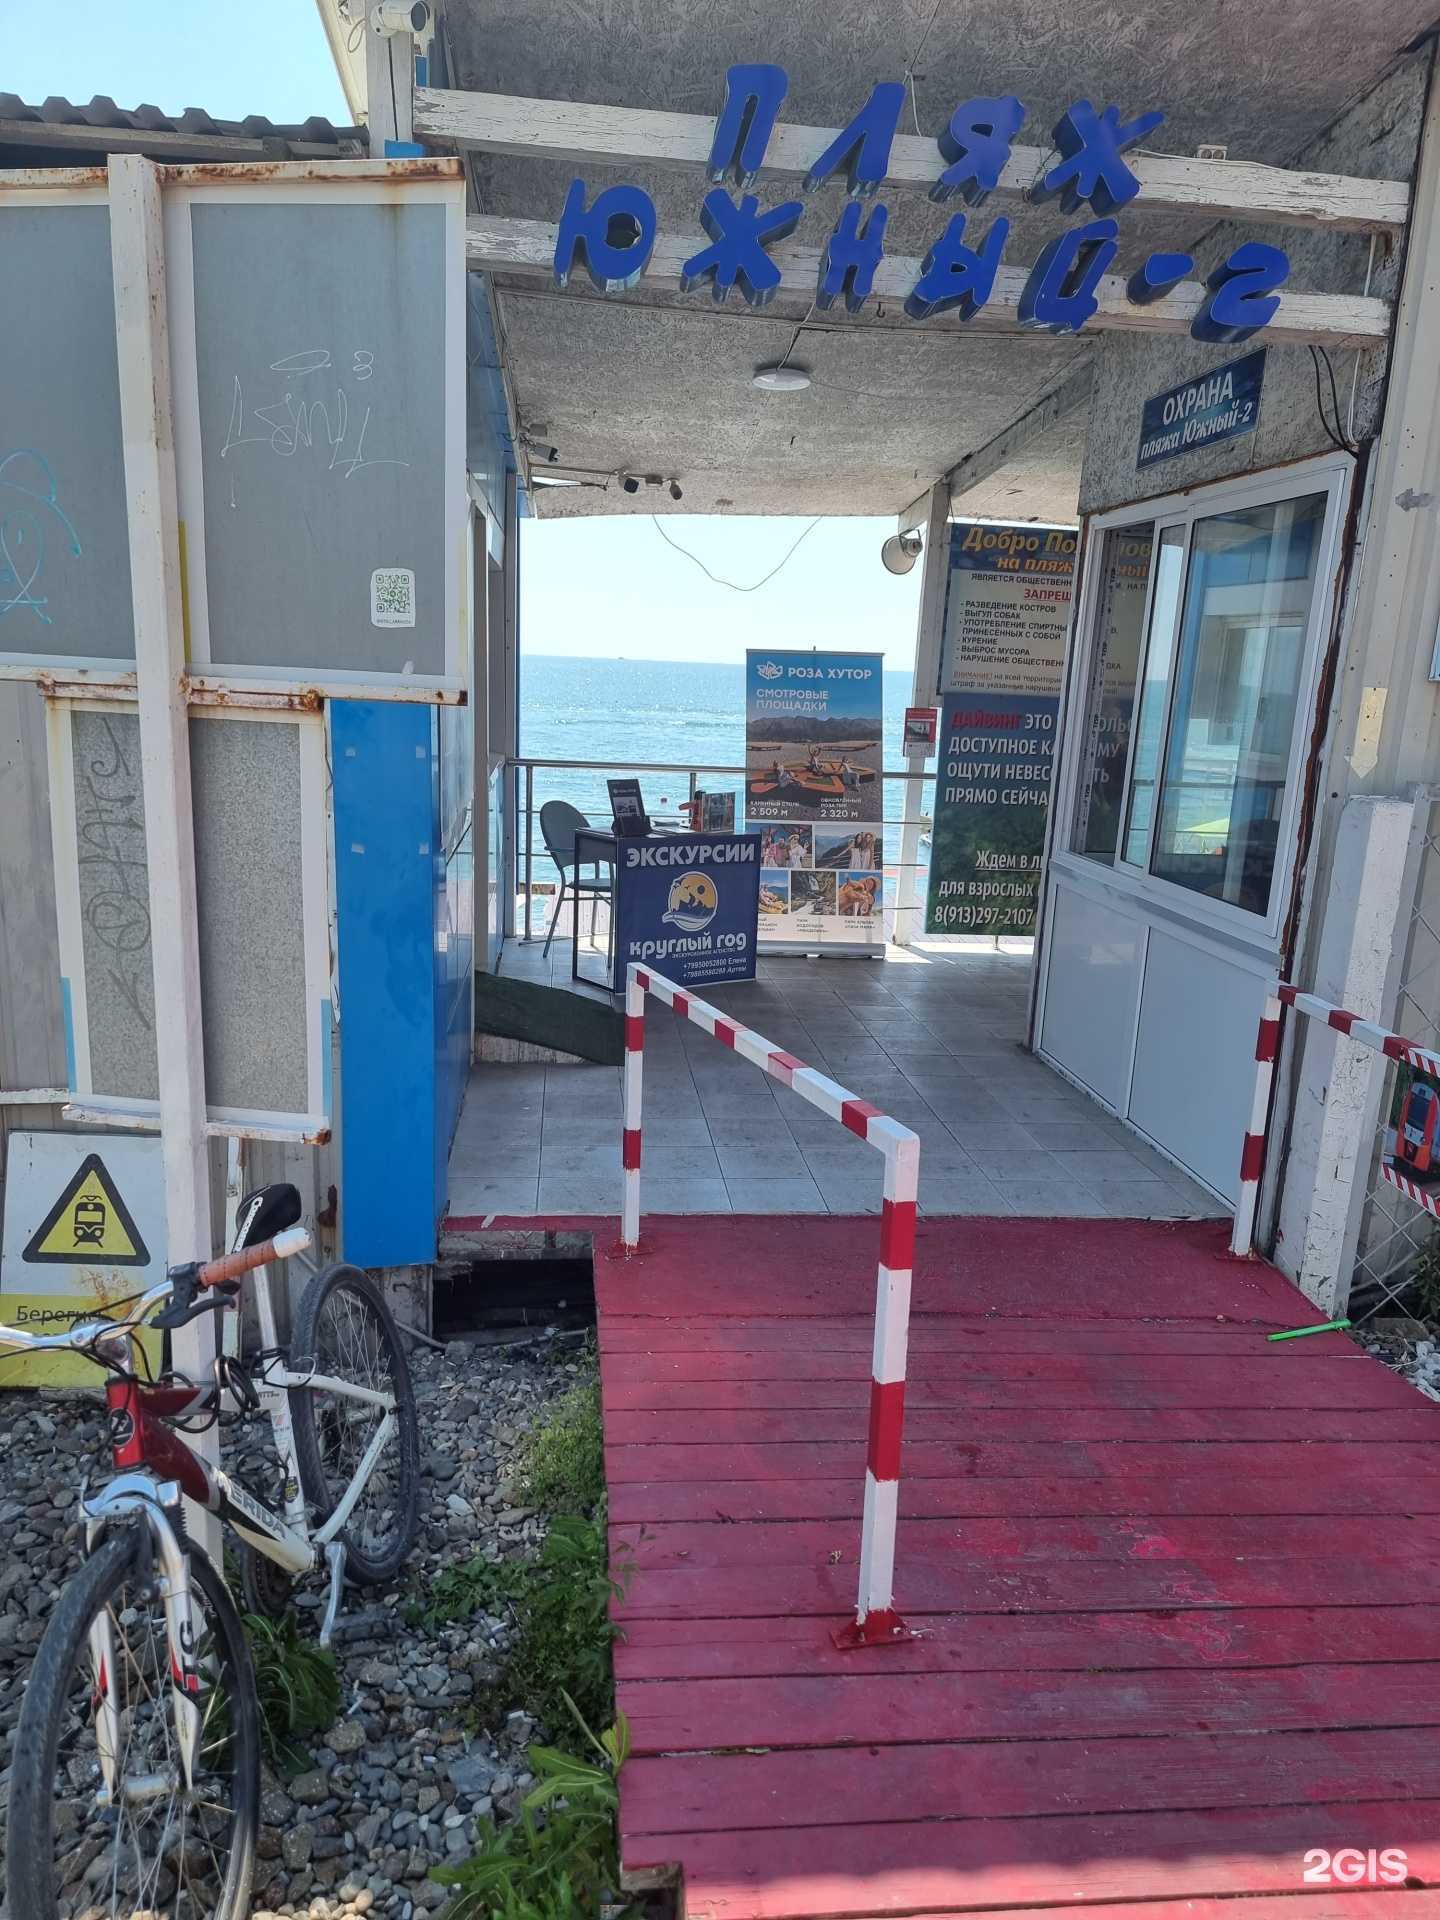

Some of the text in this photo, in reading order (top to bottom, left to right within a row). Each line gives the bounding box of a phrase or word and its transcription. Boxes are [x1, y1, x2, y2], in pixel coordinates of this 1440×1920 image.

[705, 64, 1165, 215] ПЛЯЖ
[1162, 371, 1233, 425] ОХРАНА
[1140, 400, 1253, 460] пляжа Южный-2
[961, 527, 1078, 555] Добро По
[997, 558, 1020, 570] на
[971, 573, 1014, 584] ЯВЛЯЕТСЯ
[965, 600, 1057, 613] РАЗВЕДЕНИЕ КОСТРОВ
[965, 610, 1021, 619] ВЫГУЛ СОБАК
[963, 619, 1026, 629] УПОТРЕБЛЕНИЕ
[962, 628, 1023, 638] ПРИНЕСЕННЫХ
[1033, 631, 1061, 640] СОБОЙ
[962, 637, 998, 645] КУРЕНИЕ
[961, 645, 1030, 655] ВЫБРОС МУСОРА
[960, 655, 1009, 664] НАРУШЕНИЕ
[788, 667, 872, 680] РОЗА ХУТОР
[756, 688, 829, 700] СМОТРОВЫЕ
[756, 700, 827, 712] ПЛОЩАДКИ
[952, 709, 1022, 730] ДАЙВИНГ
[1024, 713, 1052, 729] ЭТО
[948, 737, 1037, 756] ДОСТУПНОЕ
[947, 762, 1000, 780] ОЩУТИ
[945, 787, 997, 804] ПРЯМО
[626, 843, 754, 868] ЭКСКУРСИИ
[976, 850, 1016, 869] Ждем
[1020, 855, 1027, 868] в
[939, 881, 1033, 900] для взрослых
[935, 904, 1033, 927] 8(913)297-2107
[629, 931, 747, 960] круглый год
[228, 1481, 287, 1539] ERIDA
